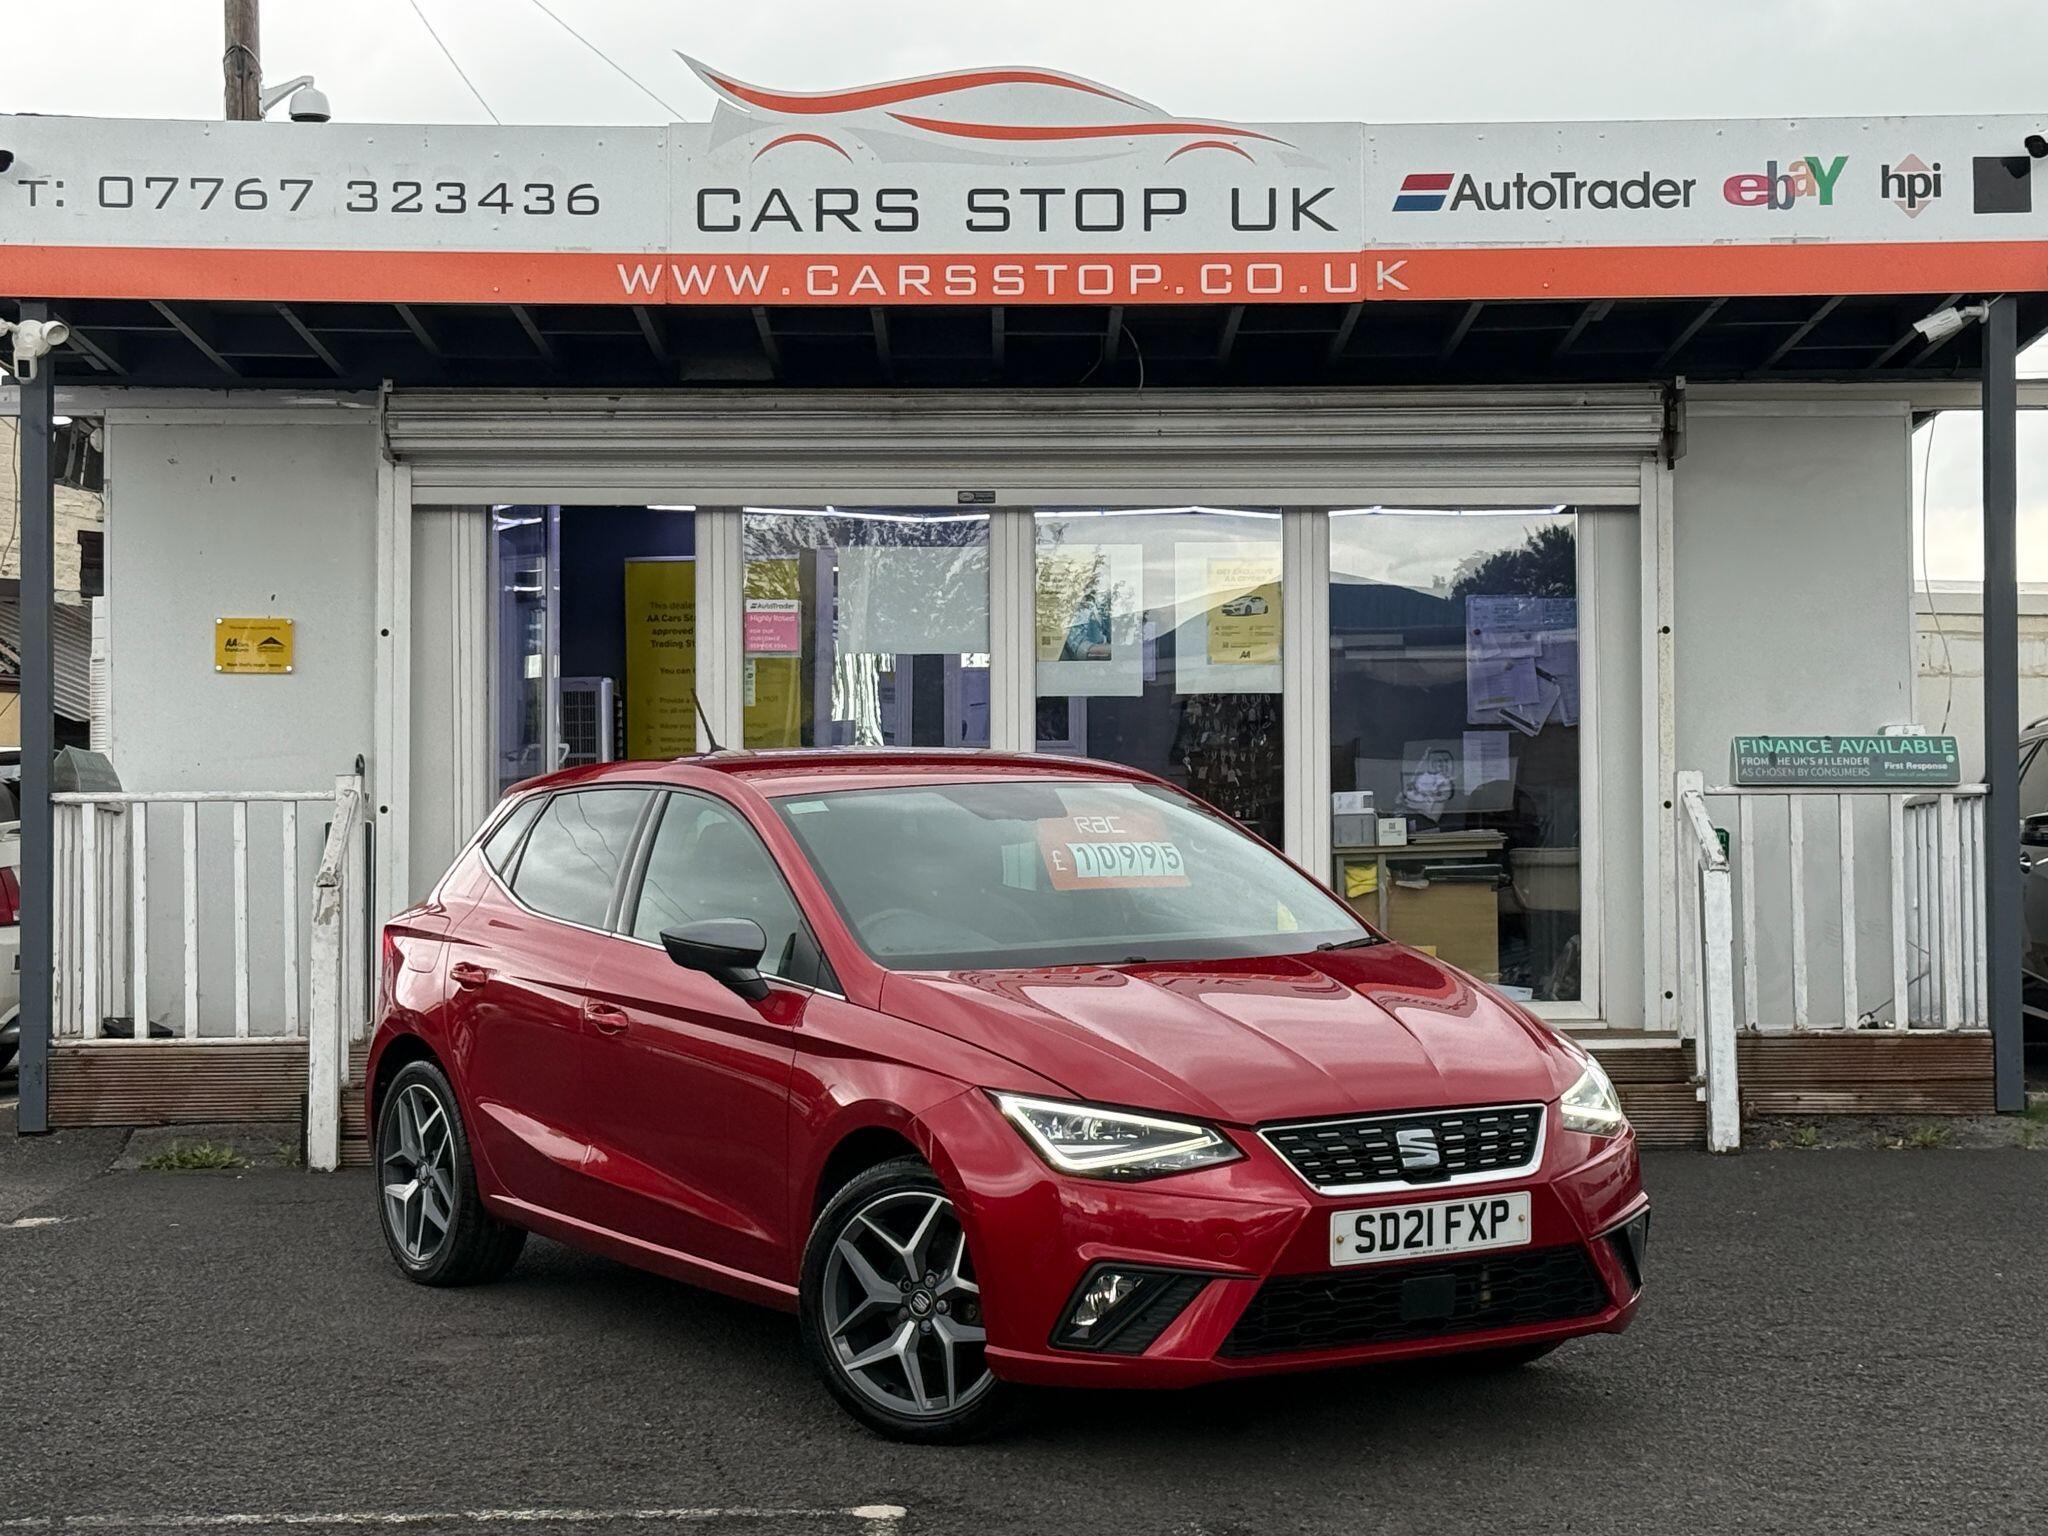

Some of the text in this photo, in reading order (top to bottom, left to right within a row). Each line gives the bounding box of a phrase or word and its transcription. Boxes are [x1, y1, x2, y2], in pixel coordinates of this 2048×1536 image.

[1450, 171, 1697, 211] AutoTrader
[1881, 162, 1942, 209] hpi
[18, 176, 600, 215] T: 07767 323436
[697, 187, 1338, 232] CARS STOP UK
[617, 260, 1410, 297] WWW.CARSSTOP.CO.UK
[647, 614, 660, 622] AA
[661, 614, 682, 622] Cars
[653, 628, 694, 637] approved
[651, 640, 684, 650] Trading
[1740, 738, 1955, 754] FINANCE AVAILABLE
[1741, 757, 1769, 766] FROM
[1772, 756, 1791, 766] HE
[1793, 756, 1816, 766] UK'S
[1831, 756, 1870, 766] LENDER
[1884, 761, 1948, 772] First Response
[1741, 767, 1870, 777] AS CHOSEN BY CONSUMERS
[1354, 1199, 1510, 1254] SD21 FXP
